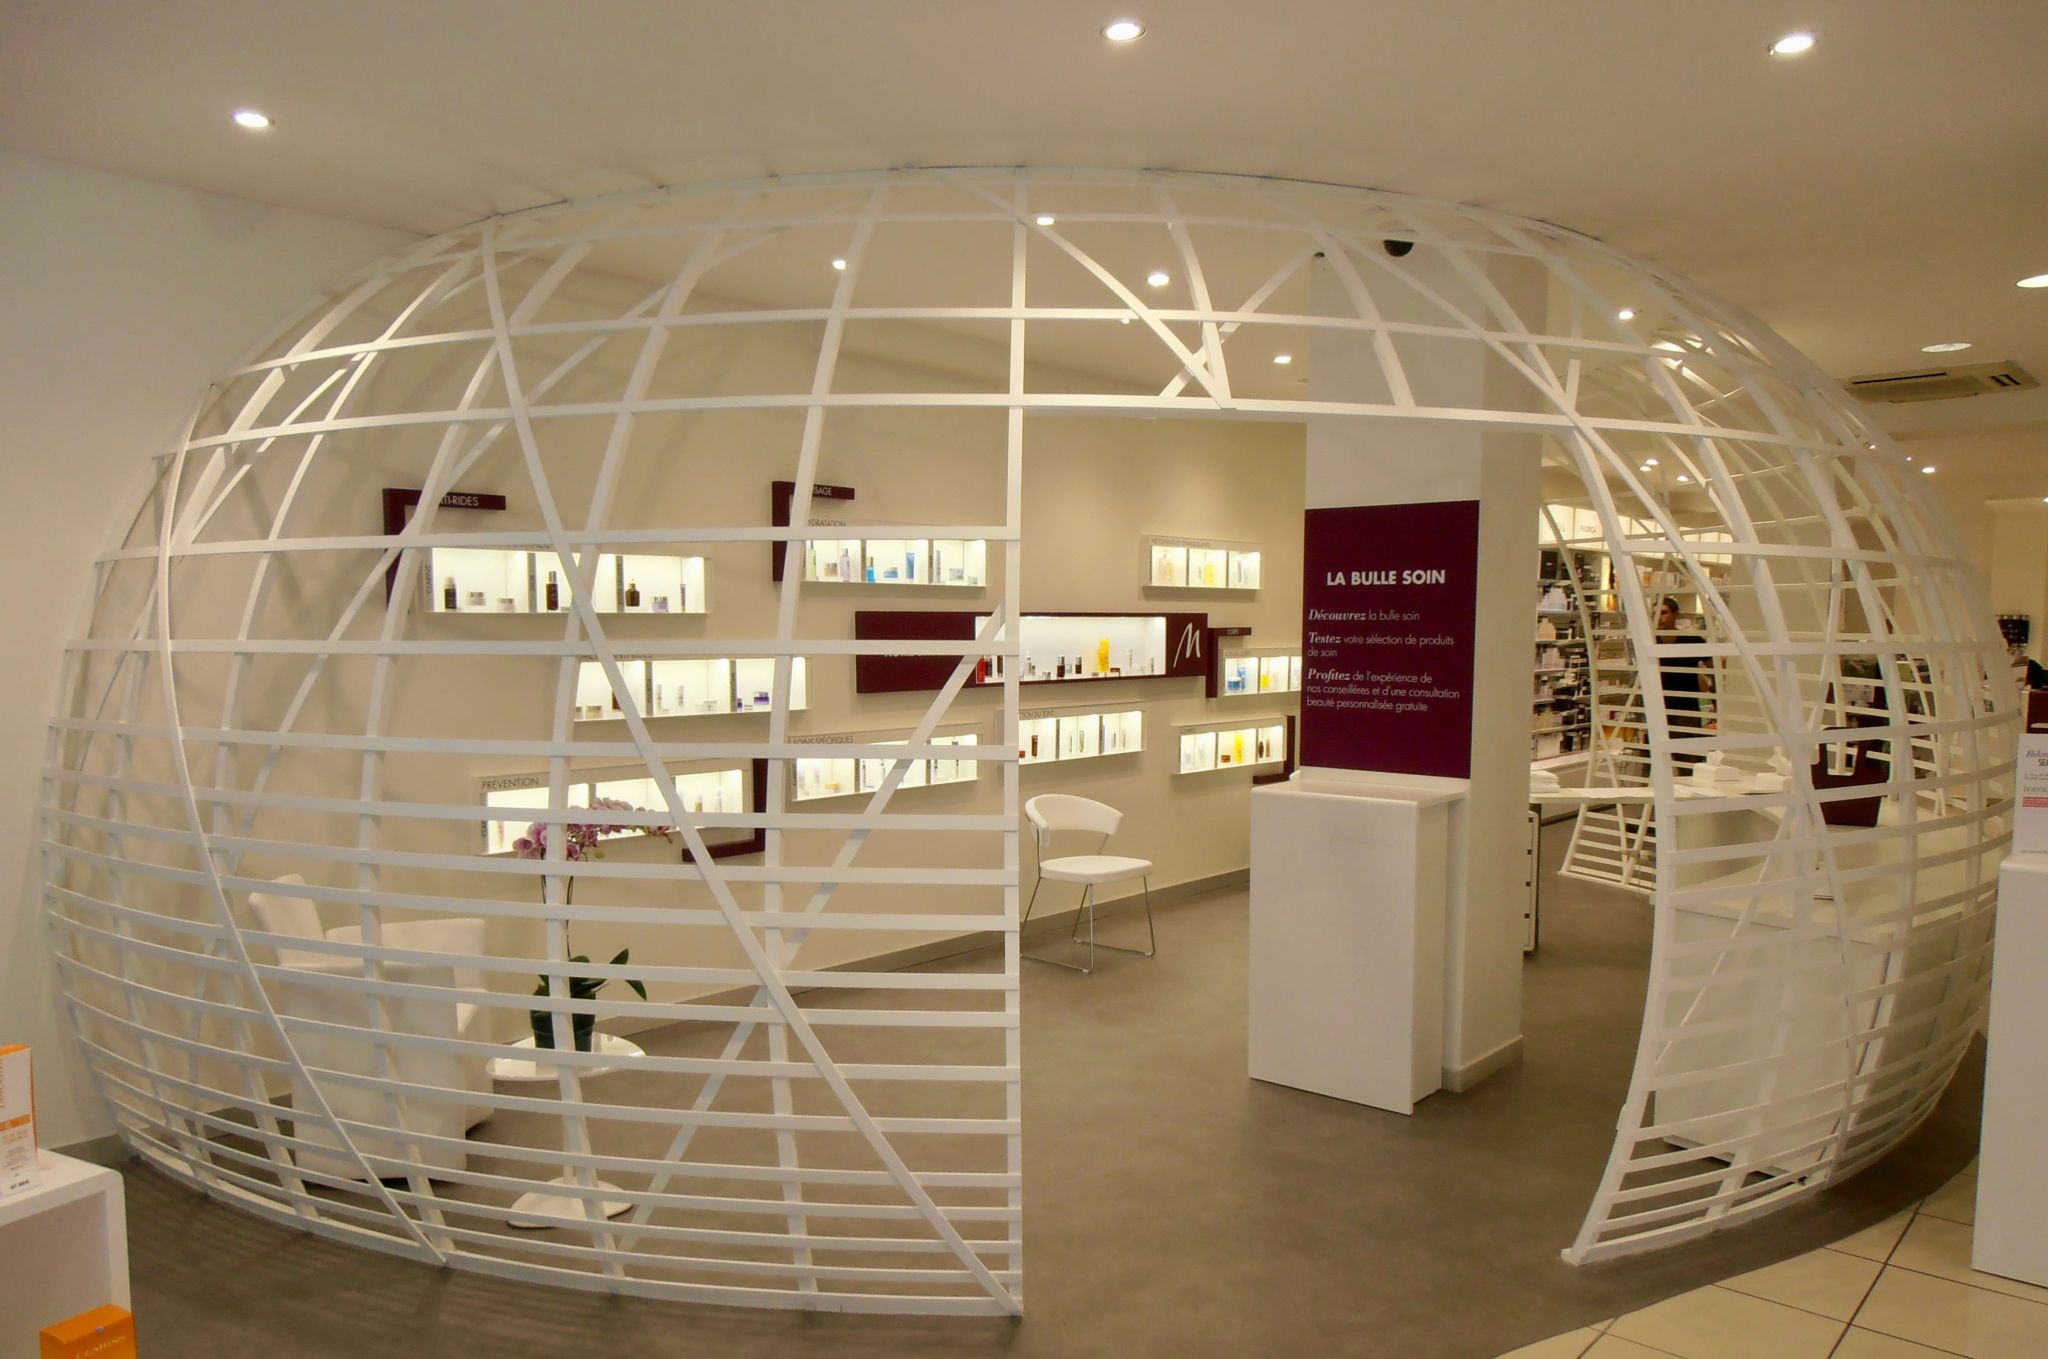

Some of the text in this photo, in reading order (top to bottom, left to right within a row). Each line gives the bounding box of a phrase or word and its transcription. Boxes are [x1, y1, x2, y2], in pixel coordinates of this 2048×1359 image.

[813, 486, 833, 496] SAGE
[440, 495, 480, 506] TI-RIDES
[808, 518, 848, 527] YDRATATION
[1326, 568, 1447, 587] LA BULLE SOIN
[1307, 608, 1421, 621] Découvrez la bulle soin
[1307, 631, 1456, 649] Testez votre sélection de produits
[1306, 645, 1338, 658] de soin
[1306, 667, 1351, 684] Profitez
[1352, 669, 1365, 681] de
[1420, 671, 1433, 684] de
[1306, 684, 1321, 694] nos
[1322, 682, 1371, 696] conseillères
[1371, 686, 1381, 697] et
[1408, 686, 1461, 699] consultation
[1306, 695, 1429, 714] beauté personnalisée gratuite
